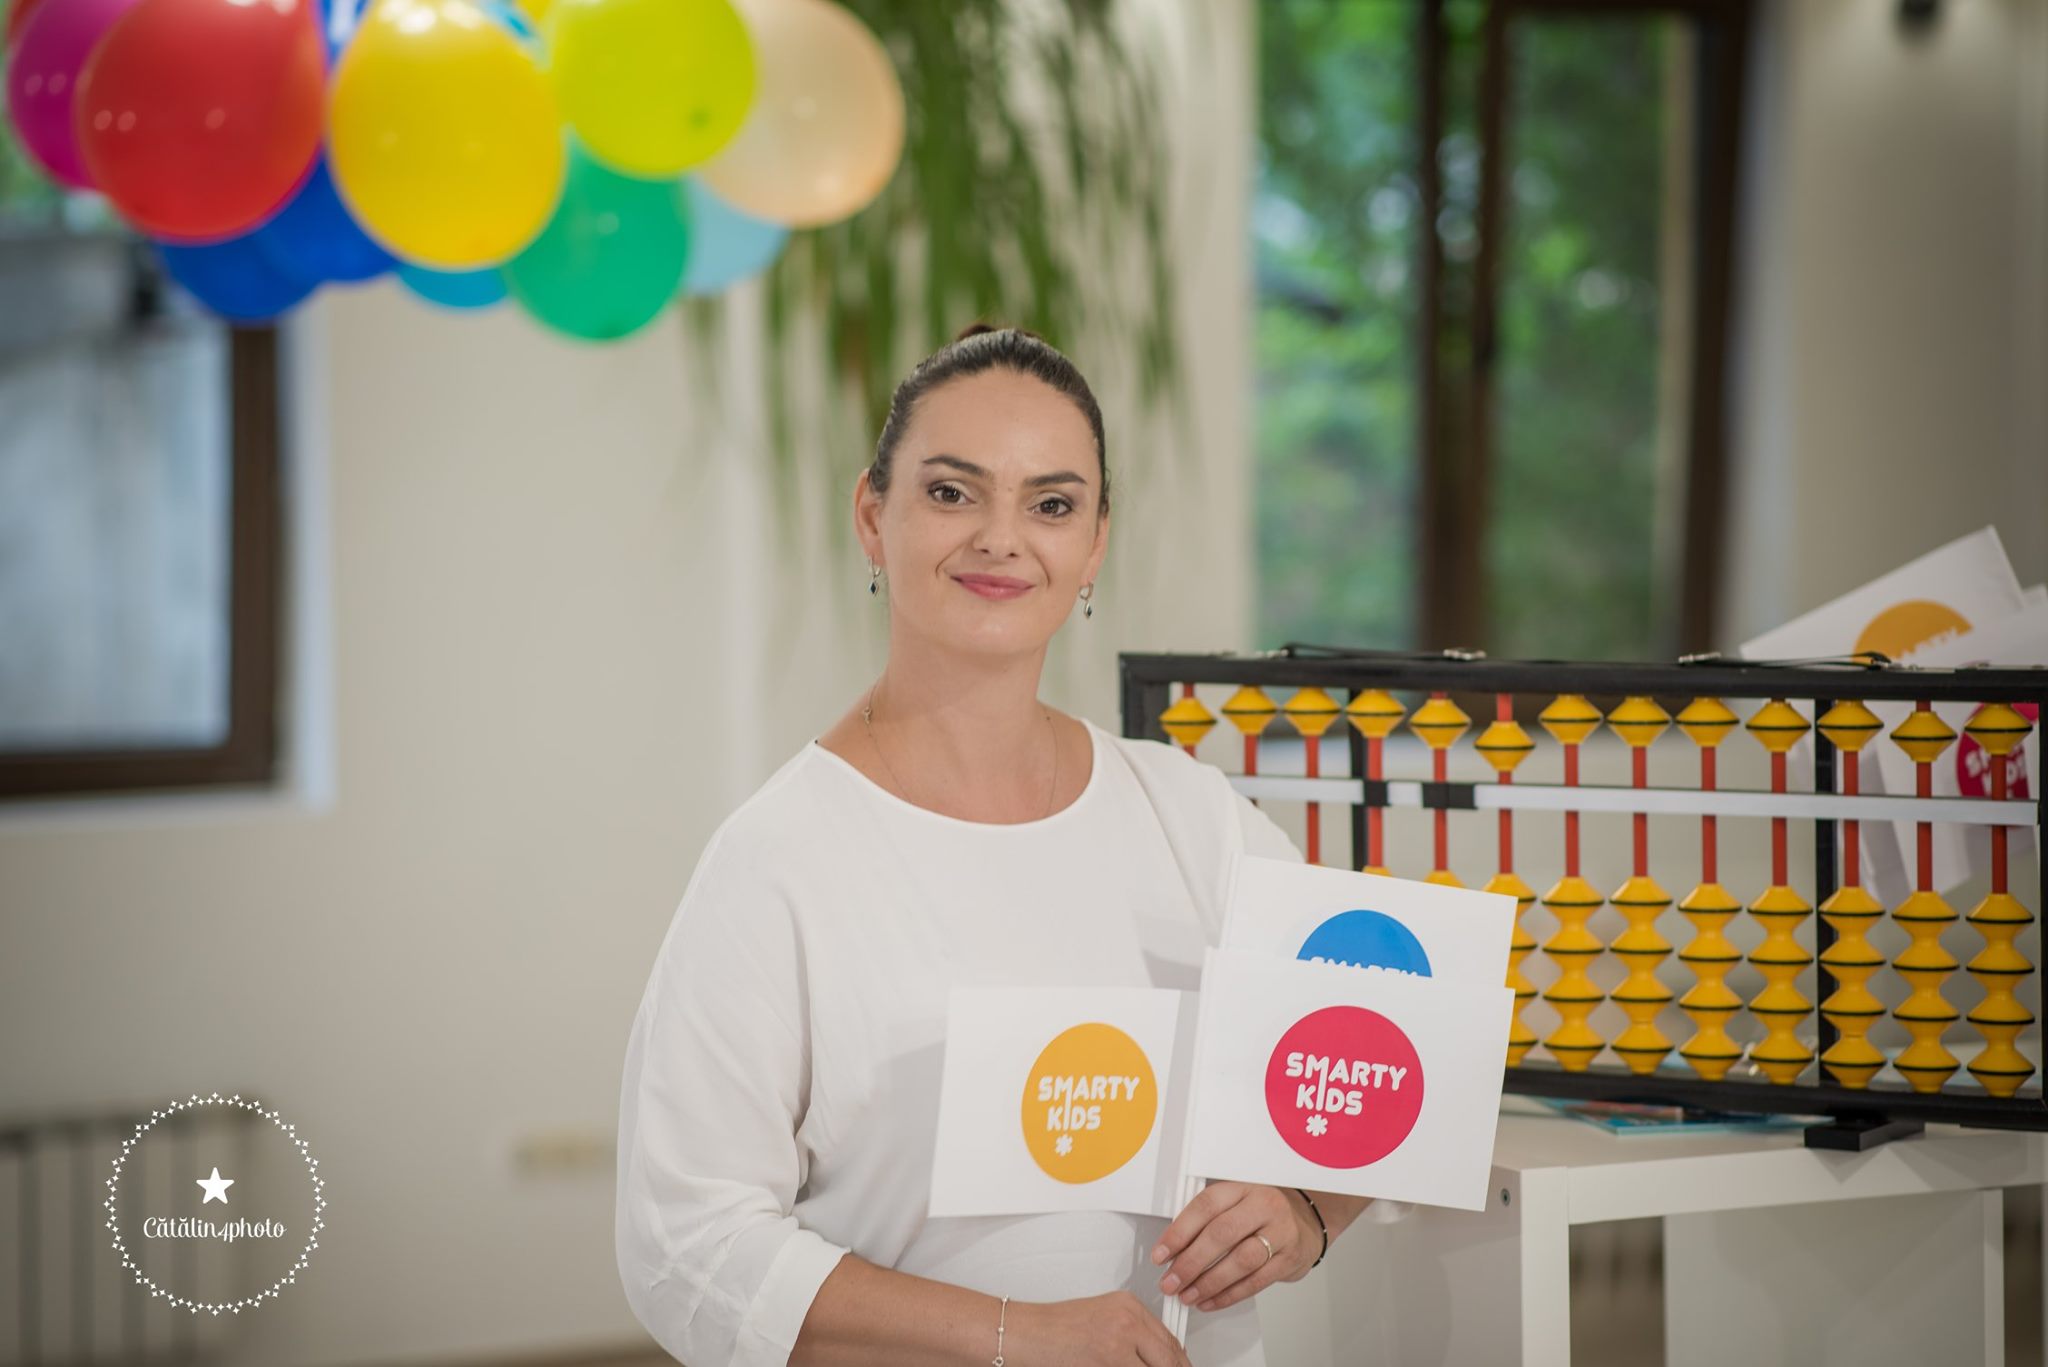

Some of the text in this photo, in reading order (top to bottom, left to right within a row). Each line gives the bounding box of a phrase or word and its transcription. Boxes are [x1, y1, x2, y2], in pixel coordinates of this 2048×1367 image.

[1285, 1052, 1408, 1092] SMARTY
[1038, 1075, 1141, 1102] SMARTY
[1296, 1083, 1364, 1116] KIDS
[1046, 1105, 1102, 1132] KIDS
